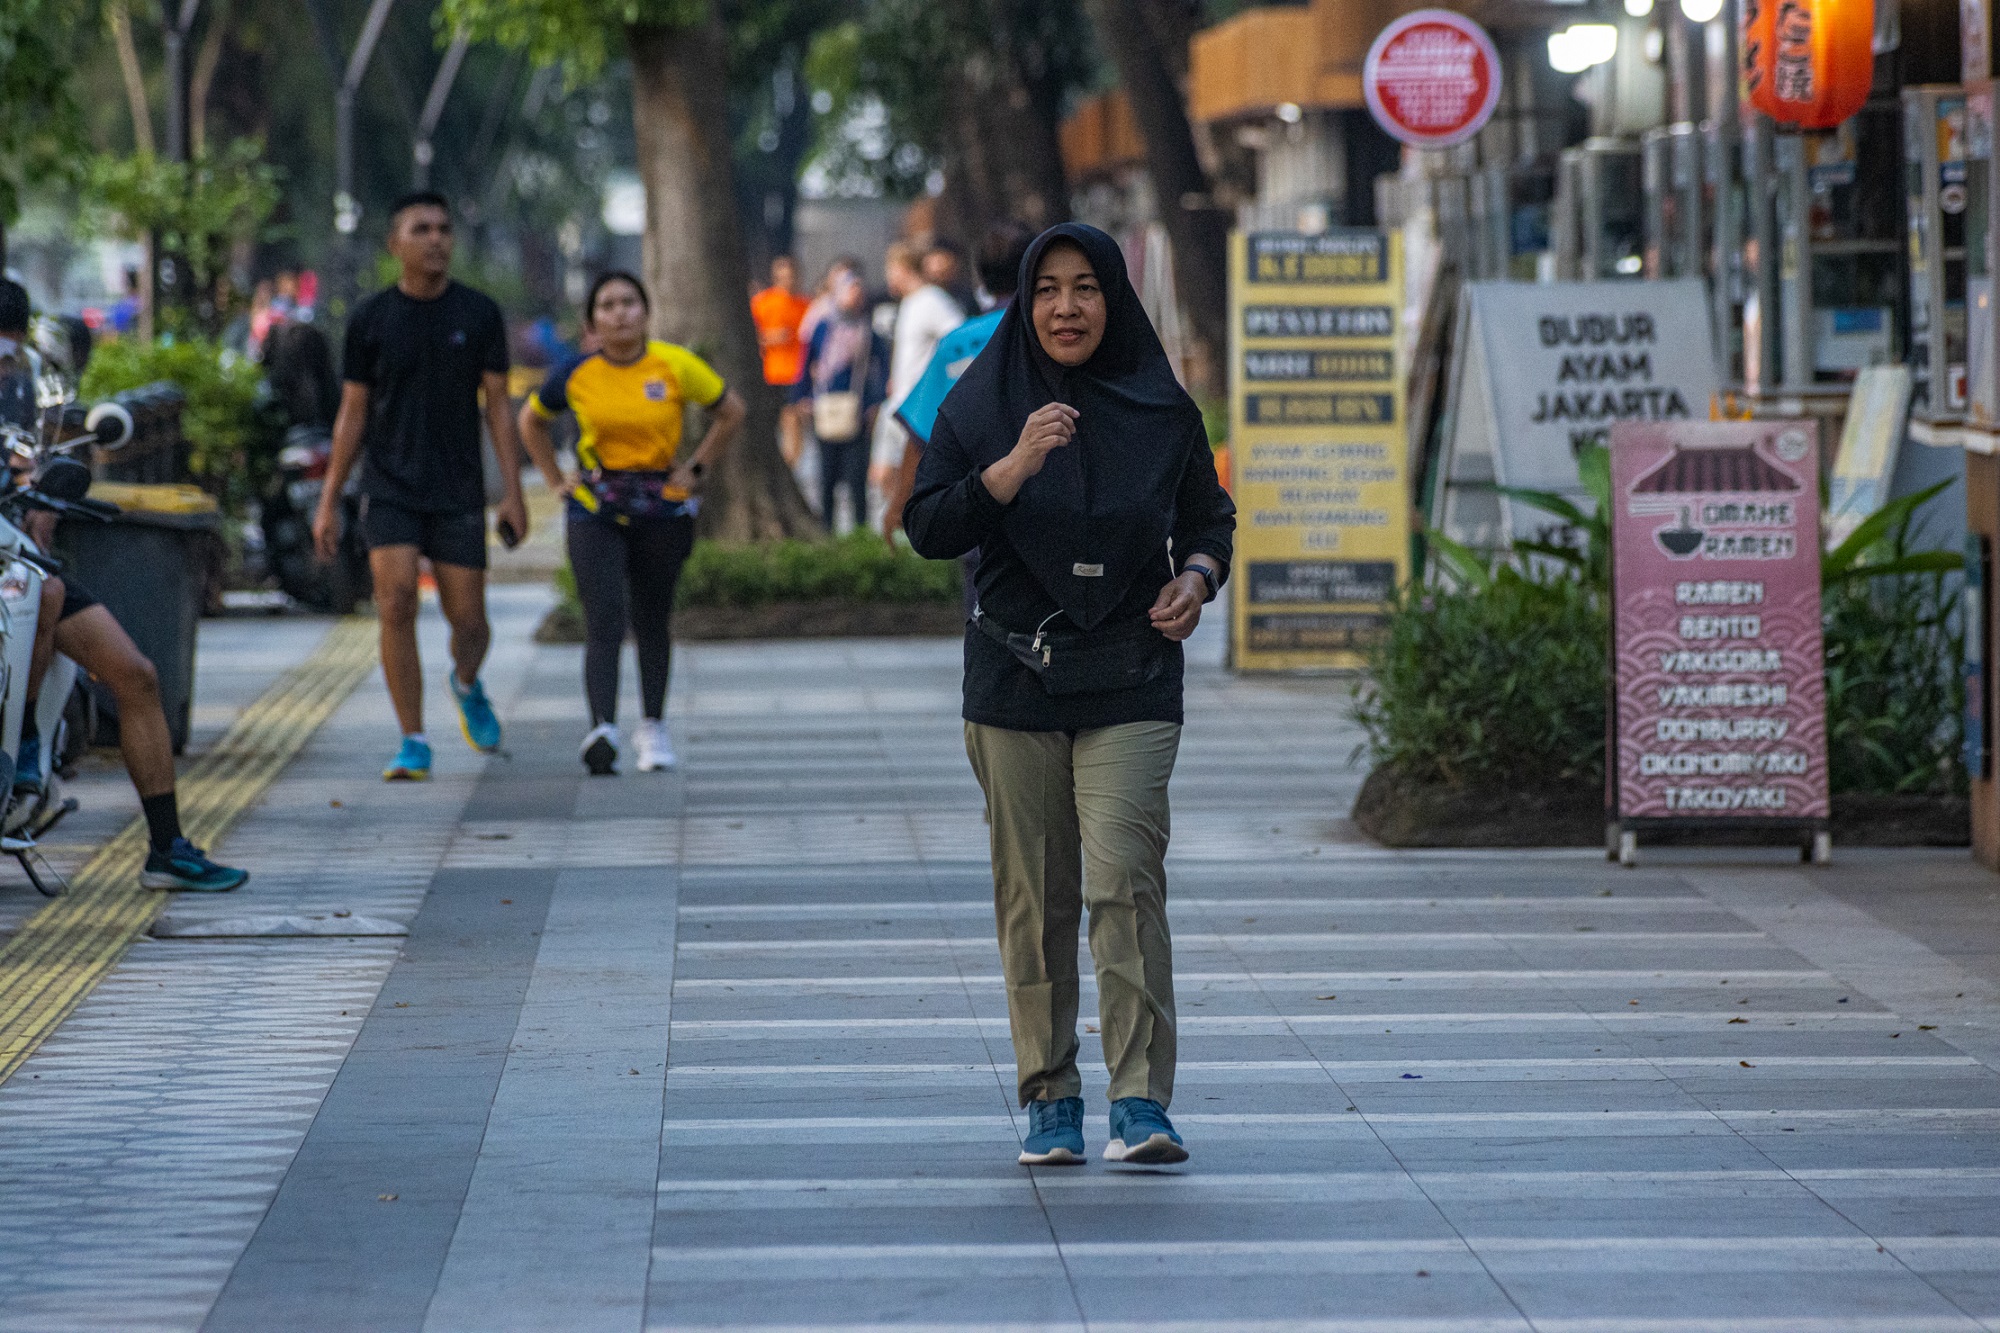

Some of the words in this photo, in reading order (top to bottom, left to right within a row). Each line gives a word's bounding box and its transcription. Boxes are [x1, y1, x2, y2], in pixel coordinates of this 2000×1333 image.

[1557, 354, 1653, 382] AYAM
[1531, 388, 1692, 424] JAKARTA
[1676, 581, 1764, 604] RAMEN
[1680, 615, 1761, 639] BENTO
[1665, 787, 1787, 809] TAKOYAKI
